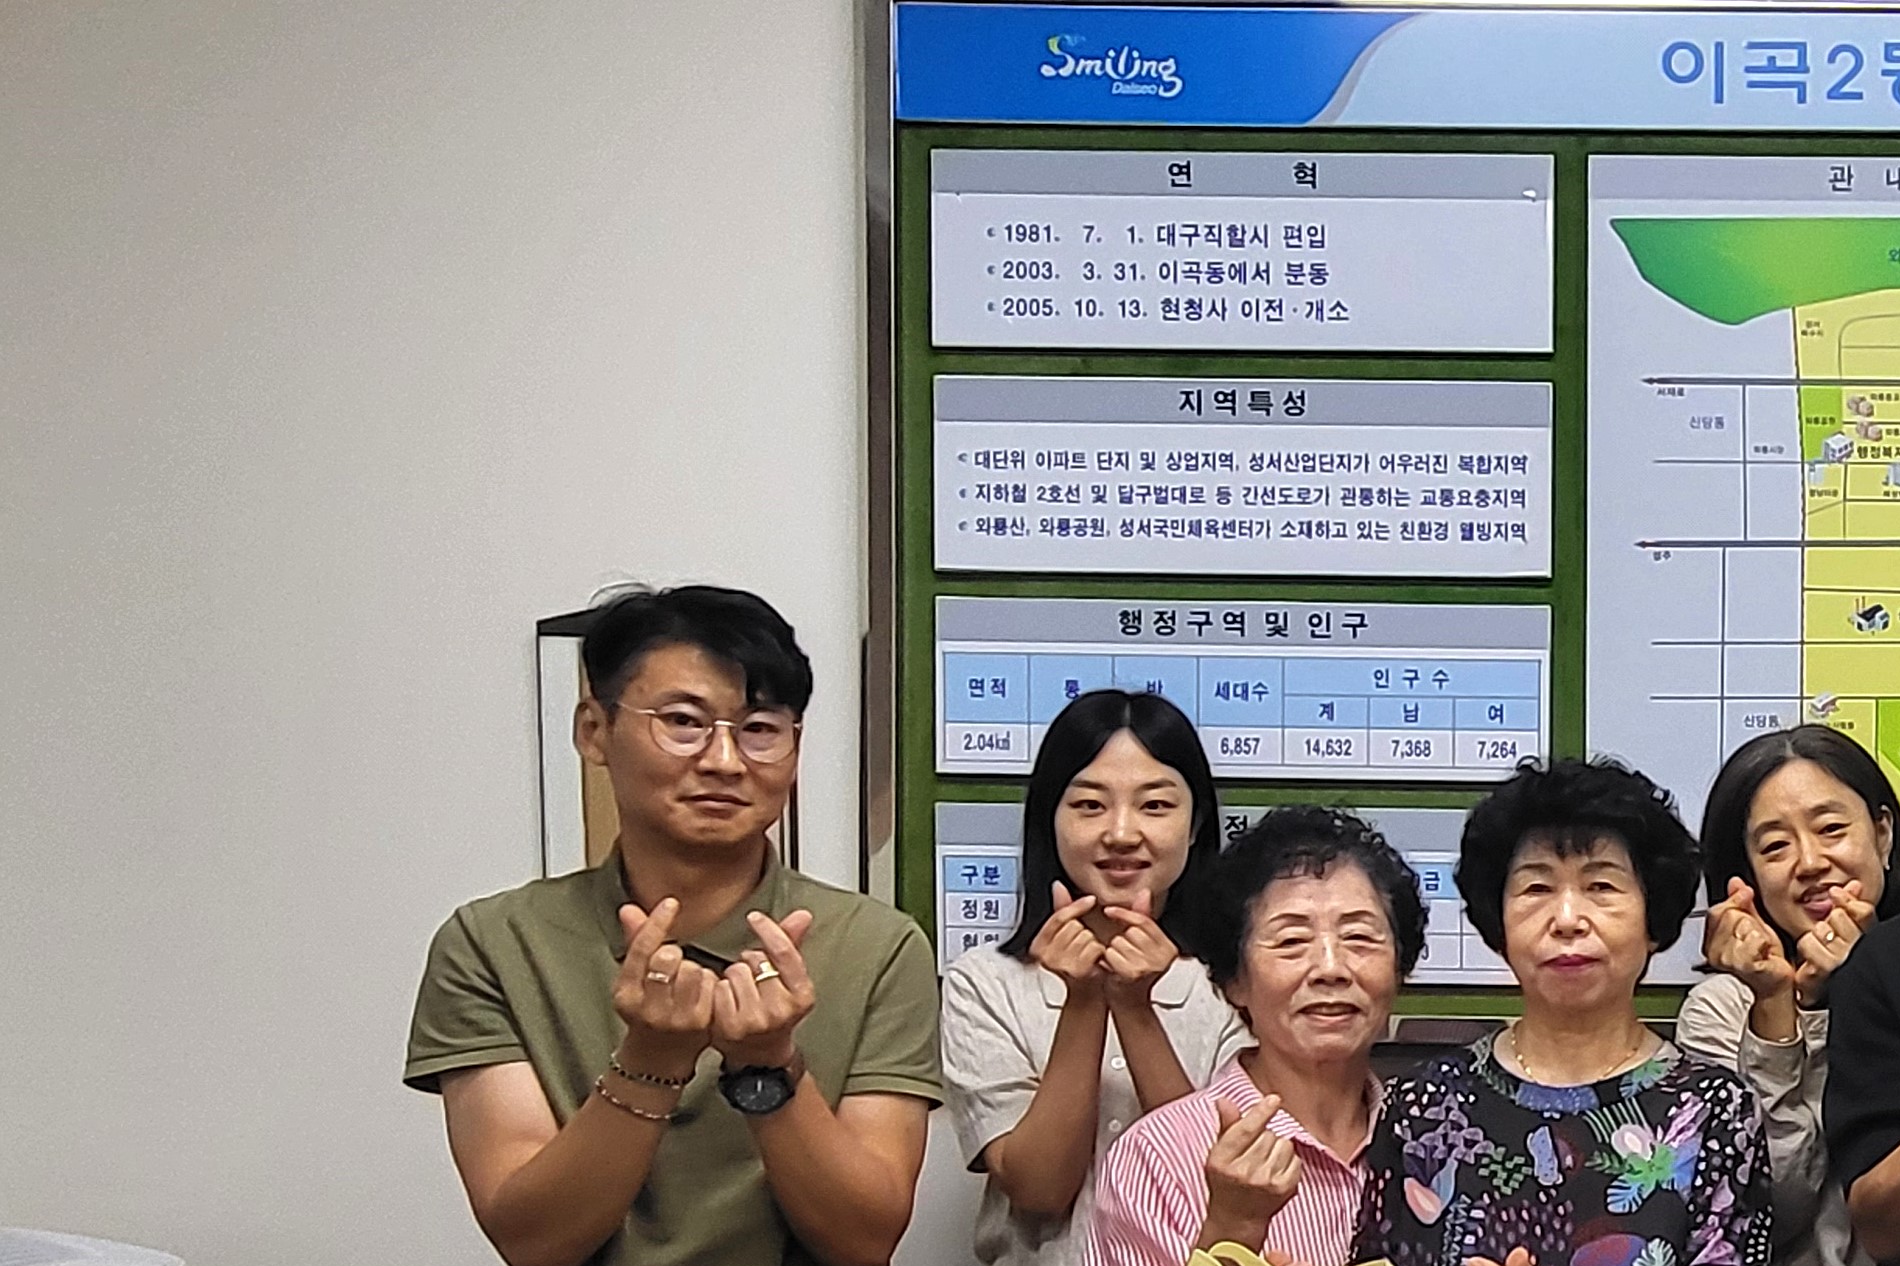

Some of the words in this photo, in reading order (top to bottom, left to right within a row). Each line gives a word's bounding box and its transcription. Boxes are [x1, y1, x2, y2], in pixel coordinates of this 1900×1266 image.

[1039, 34, 1184, 99] Smiling
[1004, 224, 1060, 244] 1981.
[1156, 223, 1270, 249] 대구직할시
[1283, 224, 1328, 250] 편입
[1003, 261, 1059, 281] 2003.
[1113, 262, 1145, 282] 31.
[1158, 261, 1272, 285] 이곡동에서
[1284, 262, 1331, 286] 분동
[1003, 298, 1059, 318] 2005.
[1117, 299, 1147, 319] 13.
[1160, 298, 1228, 323] 현청사
[1179, 388, 1309, 417] 지역특성
[1118, 609, 1248, 638] 행정구역
[1264, 610, 1290, 638] 및
[1307, 612, 1370, 640] 인구
[1220, 737, 1261, 757] 6,857
[1304, 737, 1354, 759] 14,632
[1390, 738, 1432, 760] 7,368
[1477, 739, 1517, 760] 7,264
[960, 864, 1001, 885] 구분
